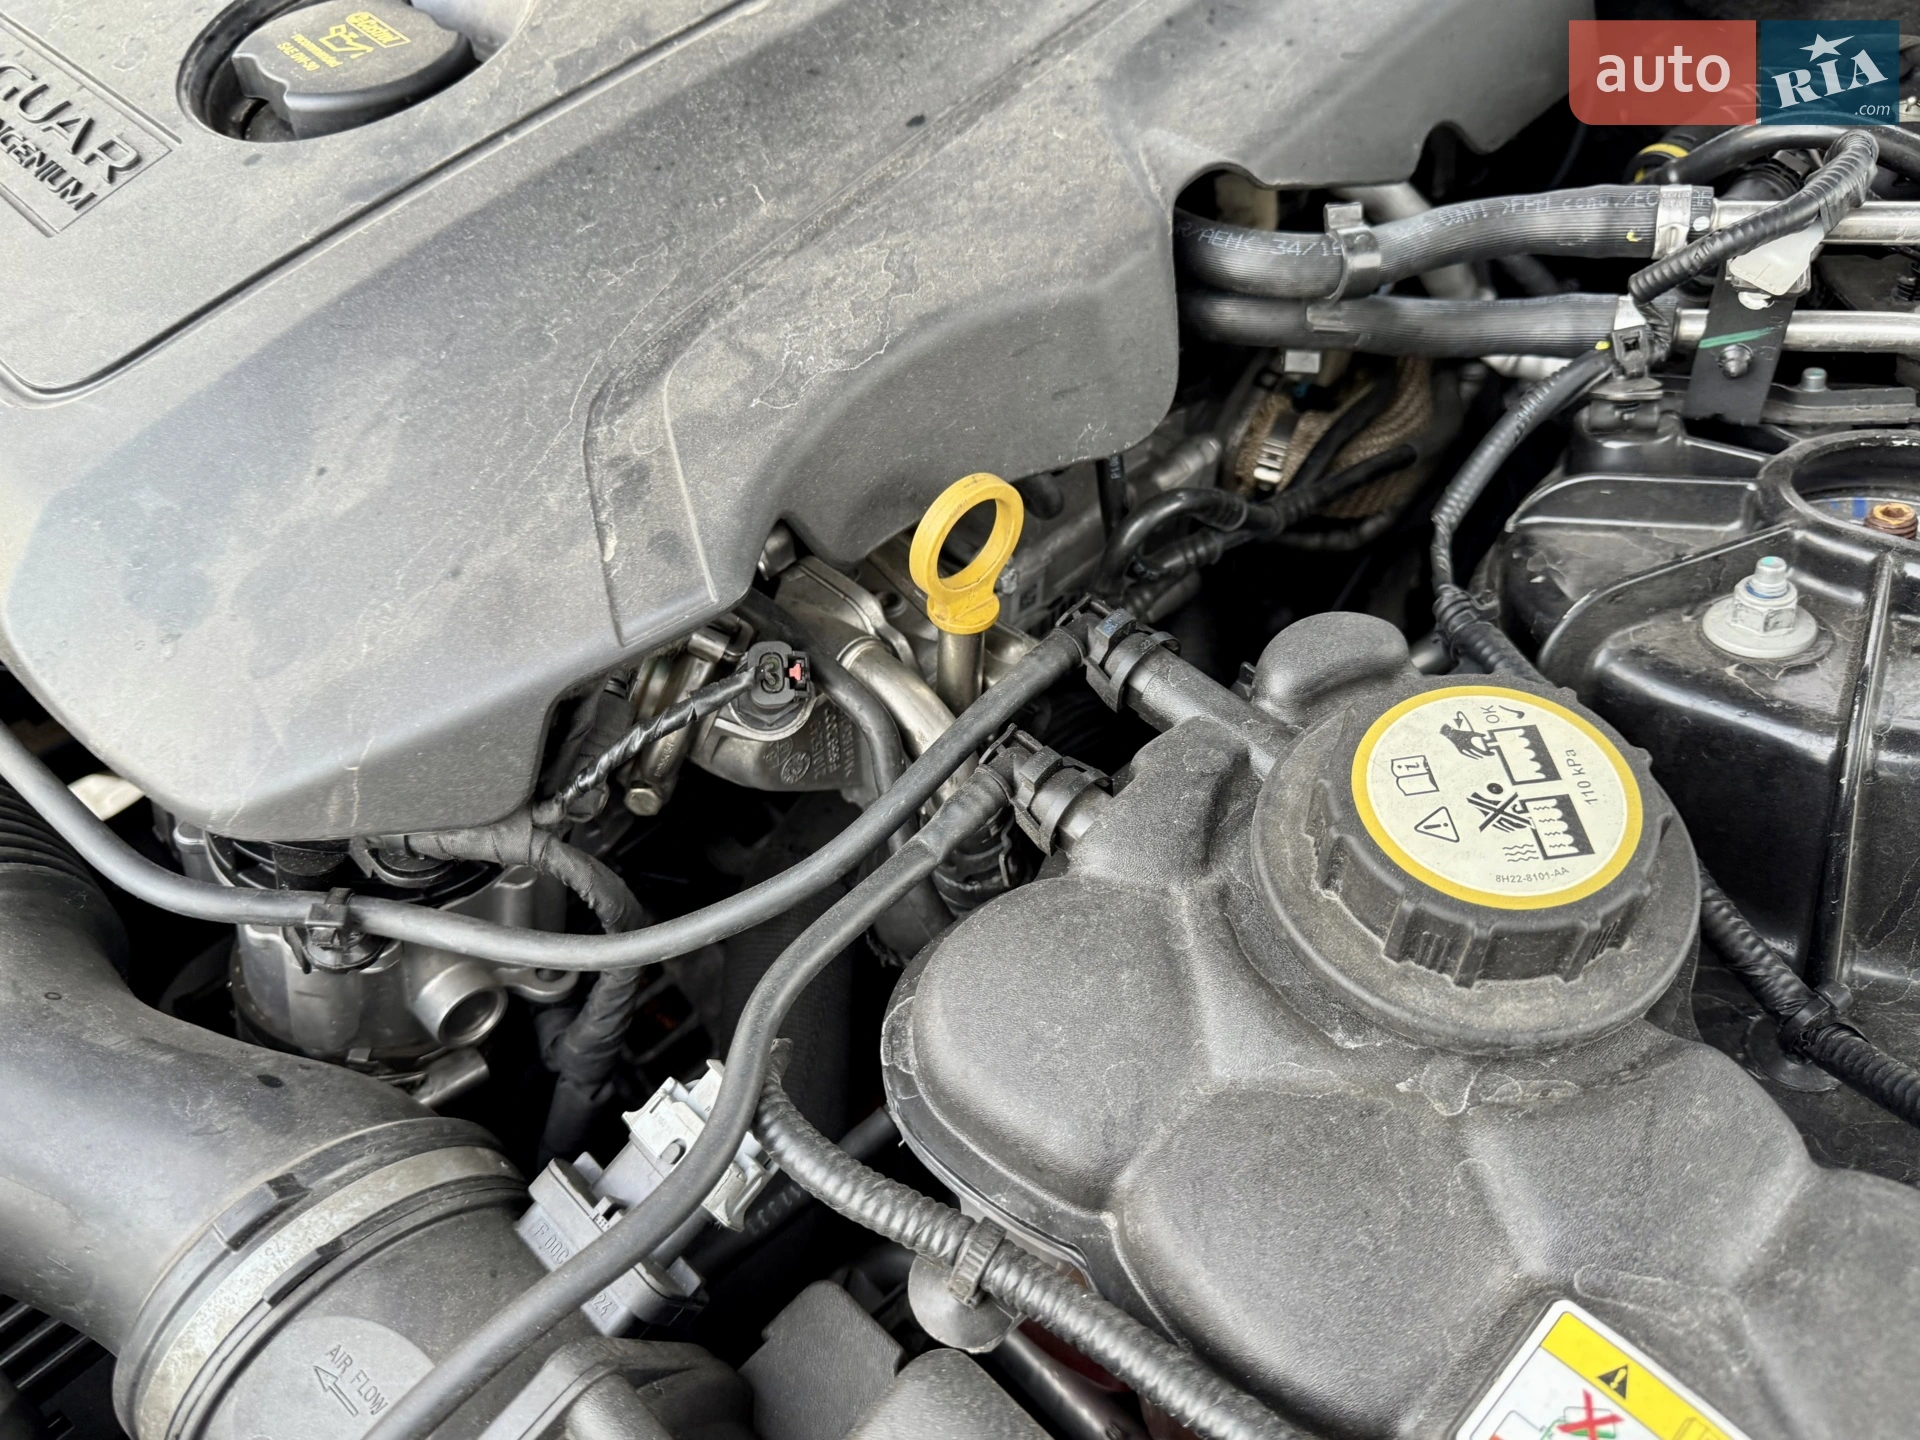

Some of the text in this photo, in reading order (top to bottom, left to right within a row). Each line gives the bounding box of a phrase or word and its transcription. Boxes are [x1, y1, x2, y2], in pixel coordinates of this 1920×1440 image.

[1480, 704, 1500, 724] OK
[1565, 749, 1598, 805] 110 kPa
[1495, 866, 1569, 883] 8H22-8101-AA
[325, 1344, 389, 1415] AIR FLOW
